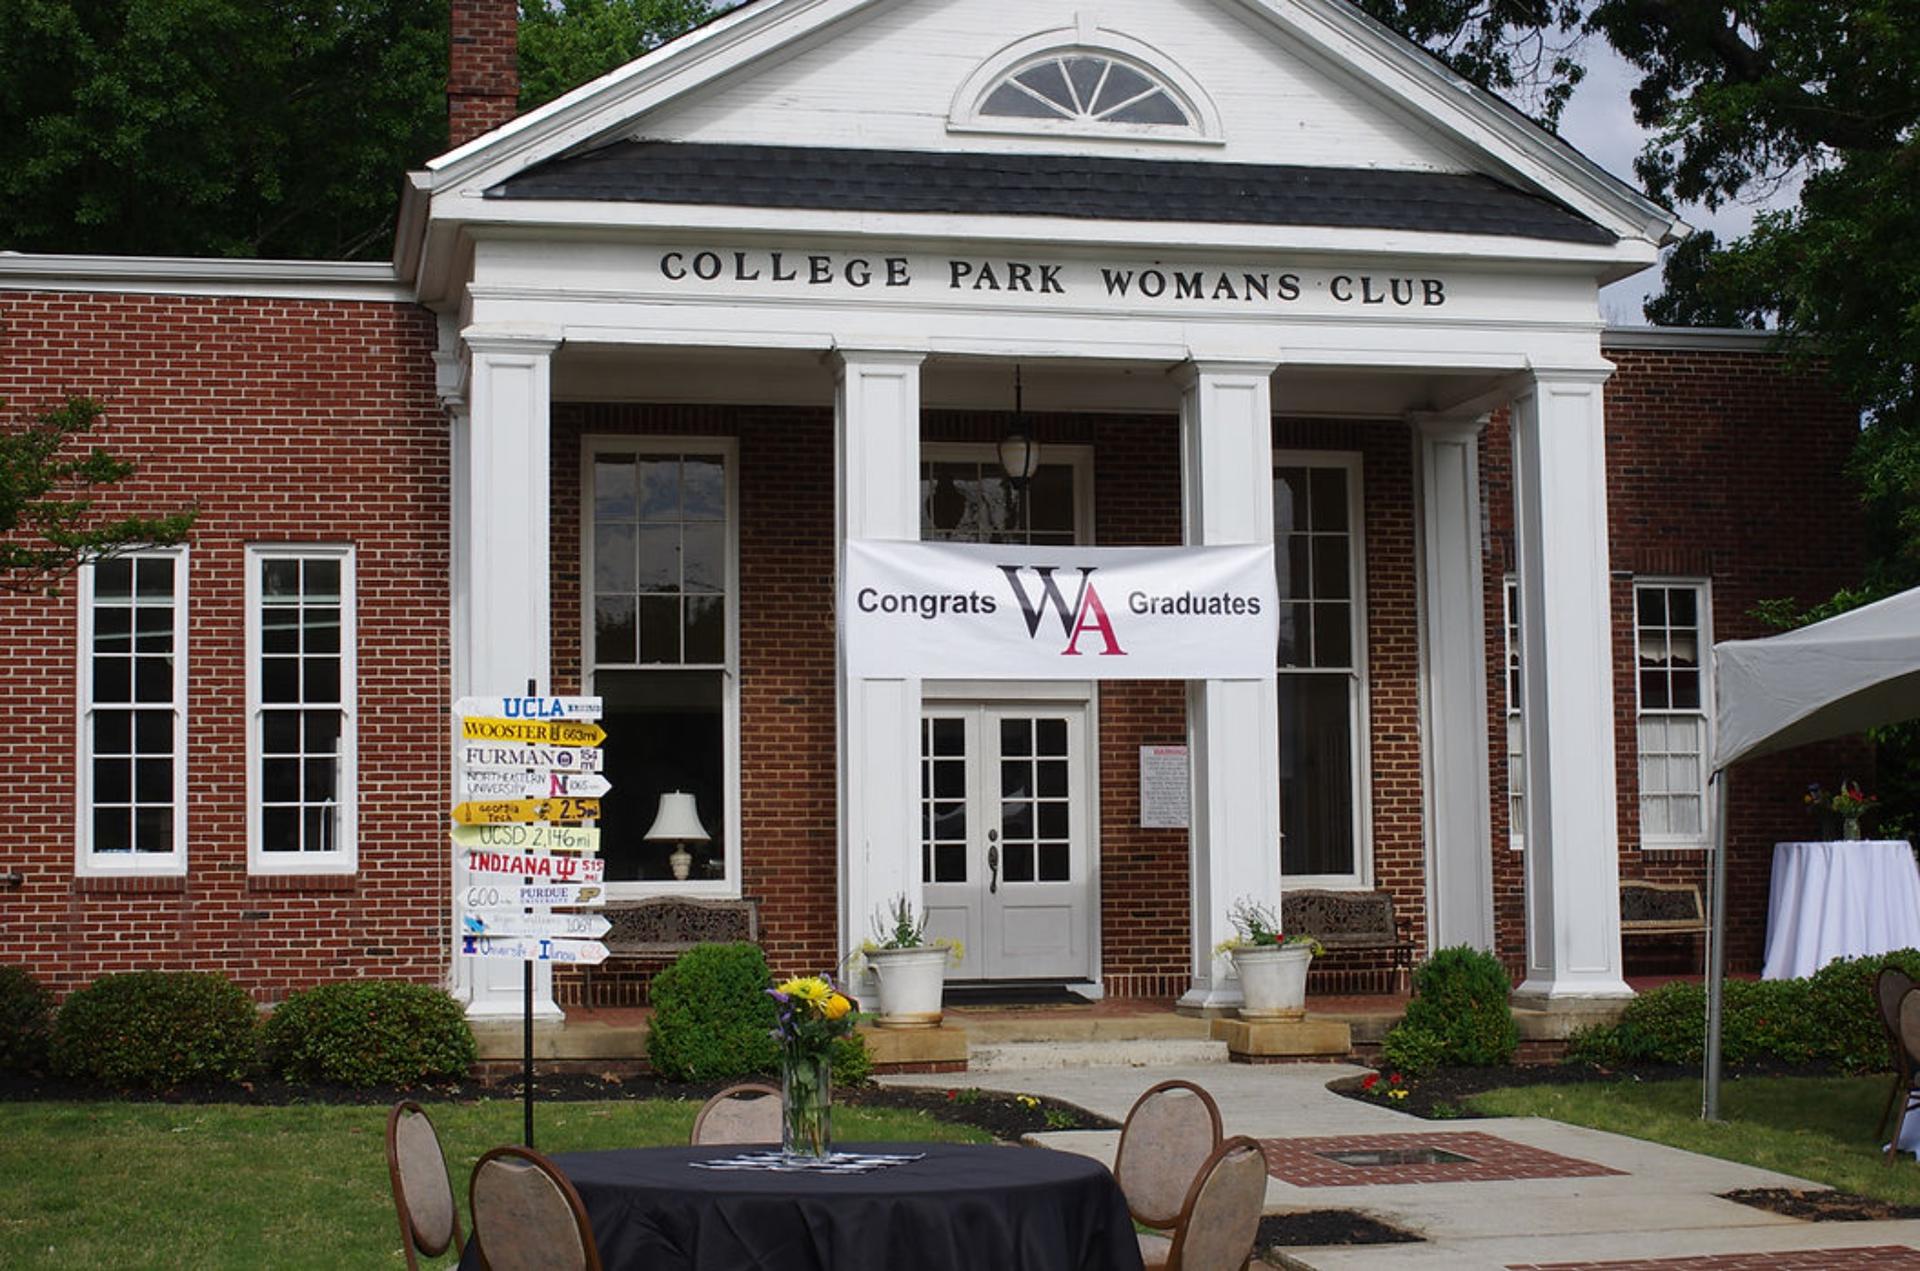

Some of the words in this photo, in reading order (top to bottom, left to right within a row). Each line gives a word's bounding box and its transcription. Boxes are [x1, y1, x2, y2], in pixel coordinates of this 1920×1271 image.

[661, 251, 911, 288] COLLEGE
[949, 261, 1066, 295] PARK
[1101, 268, 1302, 302] WOMANS
[1330, 275, 1447, 307] CLUB
[857, 587, 997, 619] Congrats
[997, 565, 1128, 655] WA
[1128, 591, 1261, 616] Graduates
[502, 697, 565, 717] UCLA
[464, 721, 547, 740] WOOSTER
[465, 748, 555, 765] FURMAN
[467, 783, 526, 795] UNIVERSITY
[550, 774, 569, 796] N
[480, 826, 527, 845] UCSD
[468, 850, 552, 876] INDIANA
[520, 888, 569, 898] PURDUE
